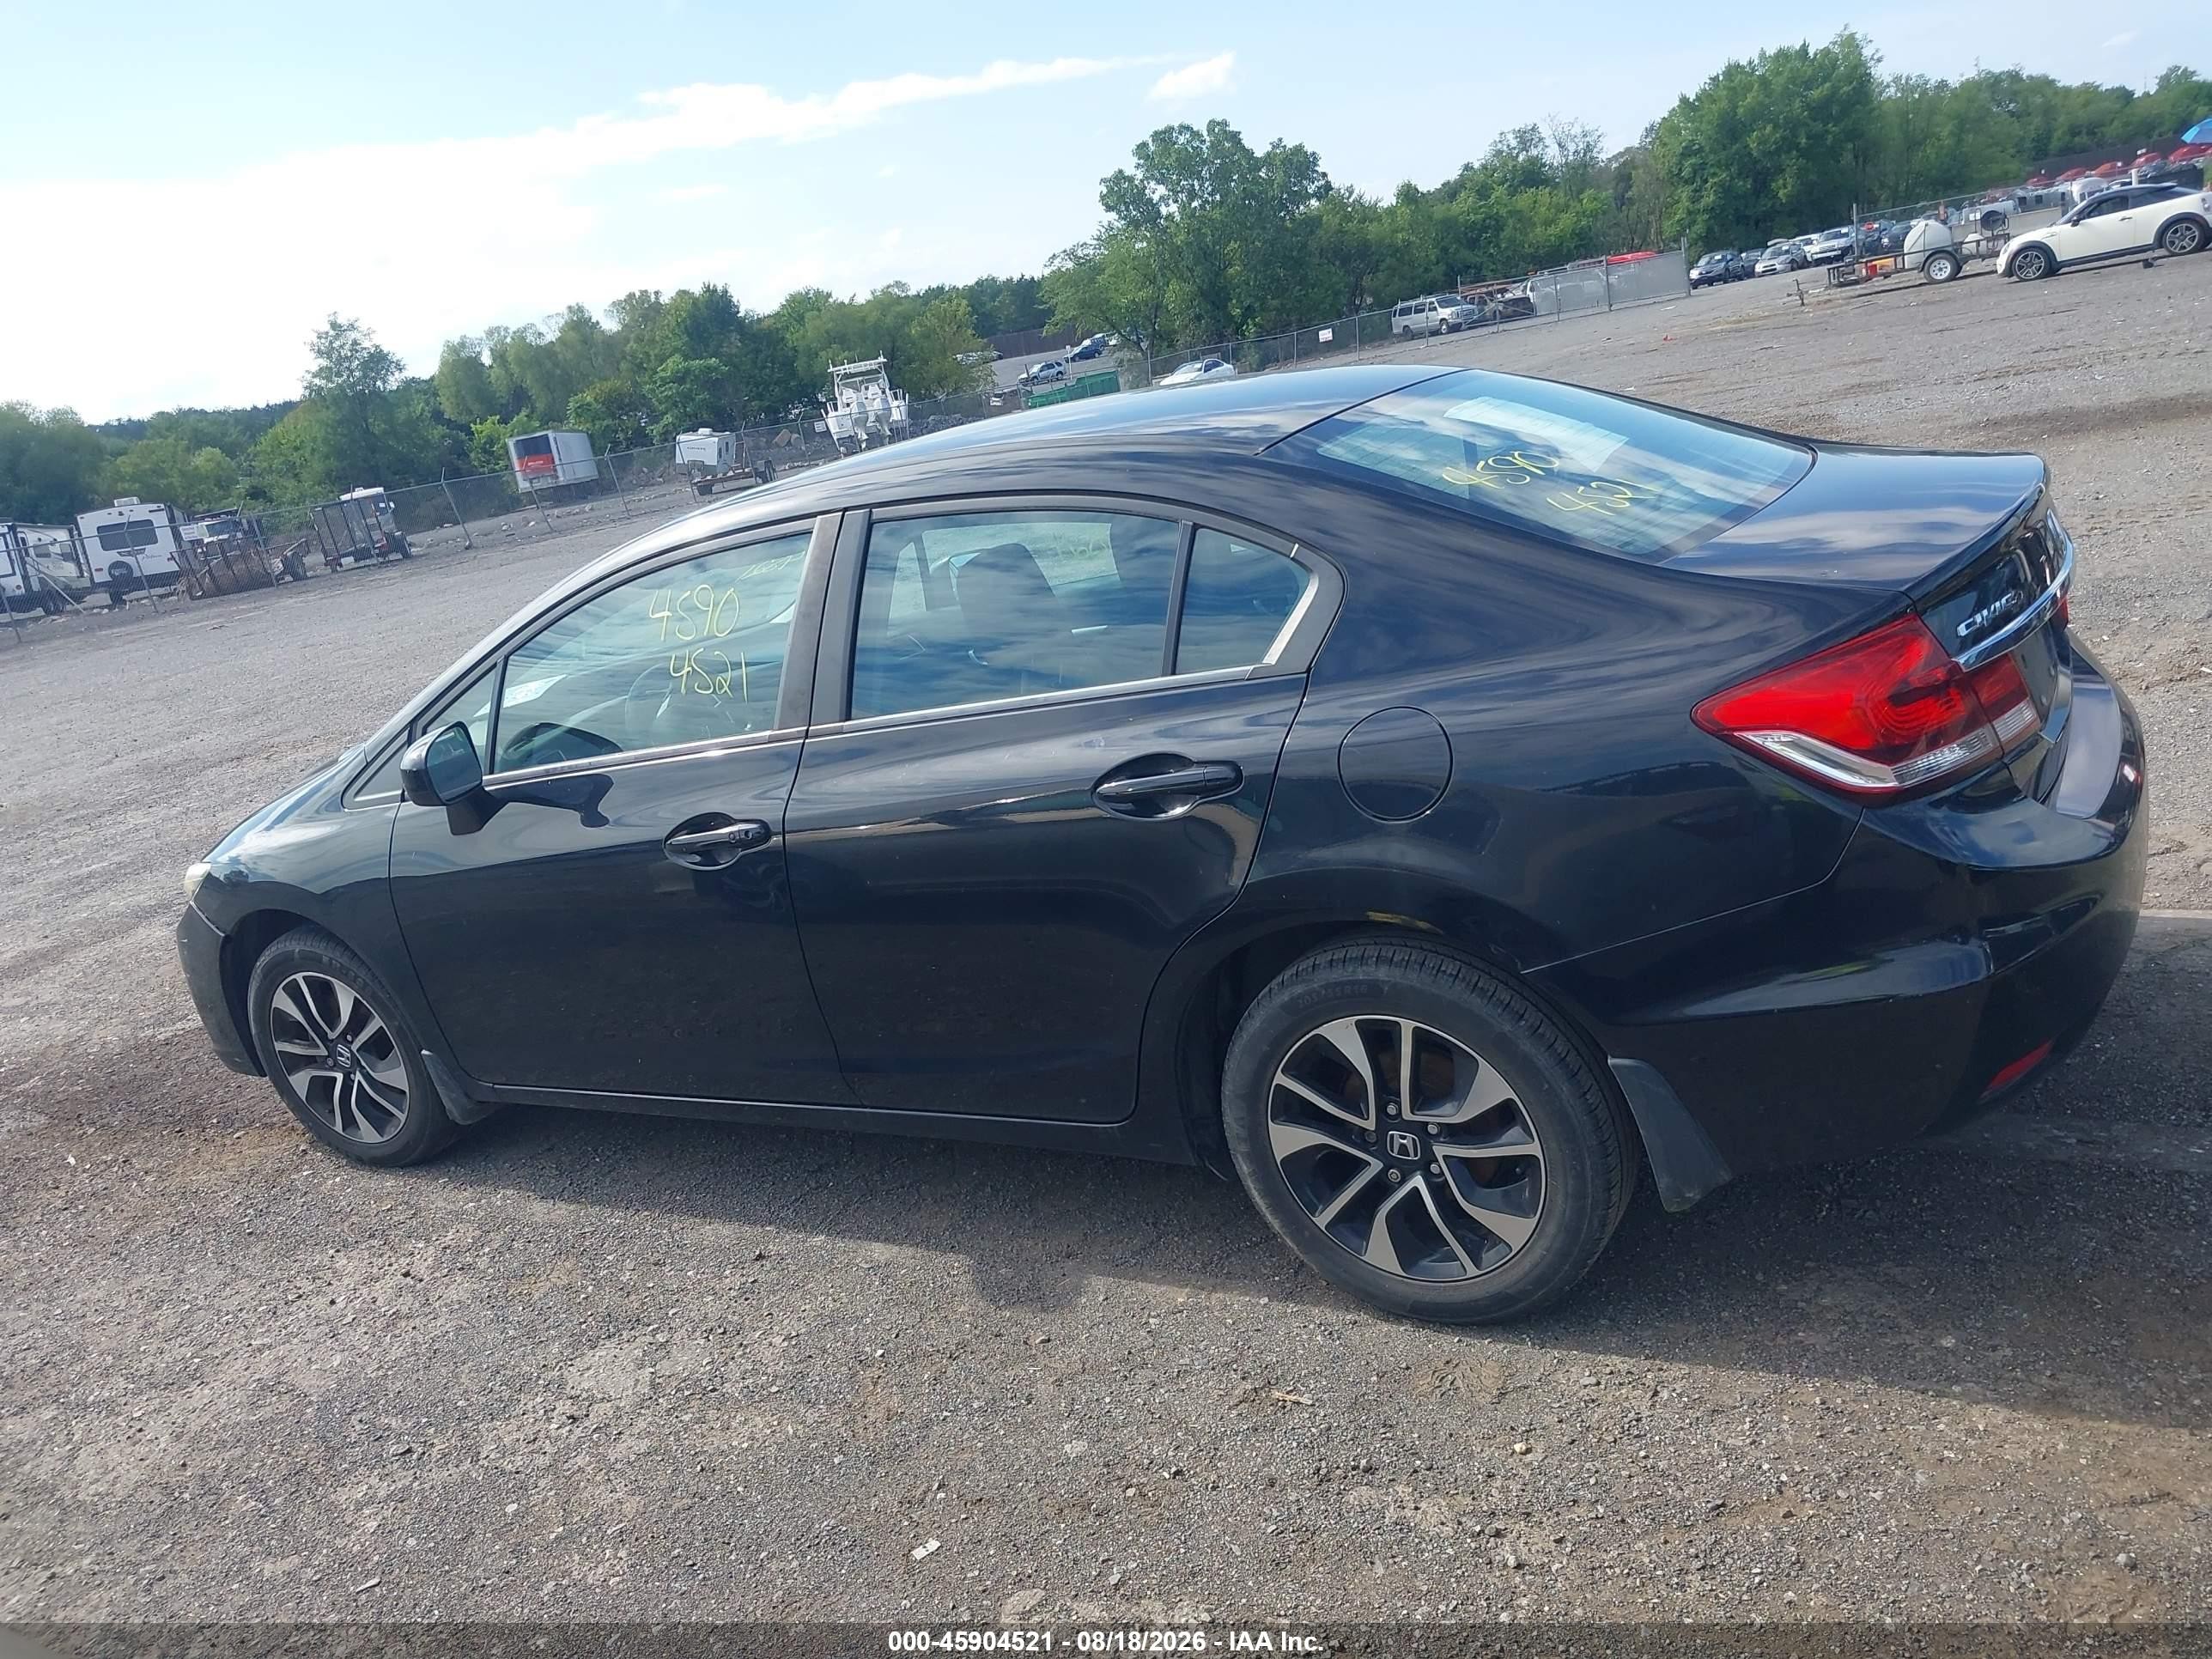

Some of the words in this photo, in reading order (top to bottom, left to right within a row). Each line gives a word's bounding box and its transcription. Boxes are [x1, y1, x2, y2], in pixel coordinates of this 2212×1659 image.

[1442, 451, 1559, 489] 4590
[1547, 478, 1662, 516] 4521
[648, 584, 740, 641] 4590
[1956, 592, 2017, 637] CIVIC
[669, 647, 748, 704] 4521
